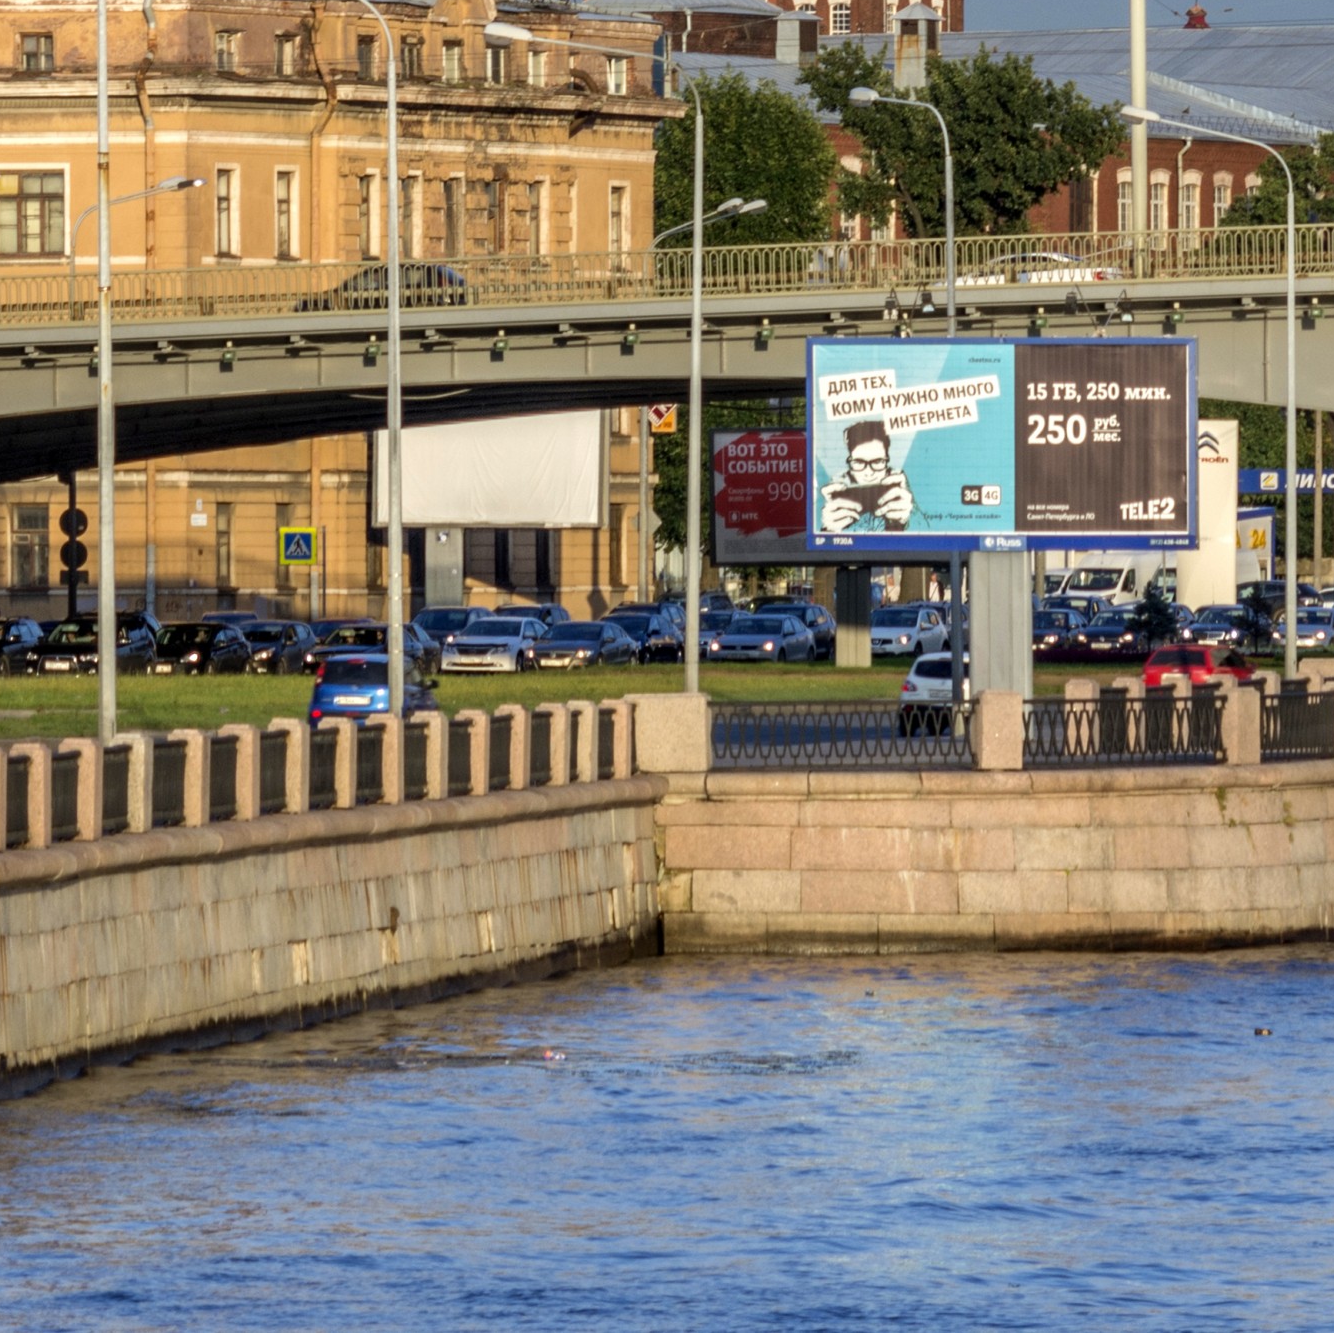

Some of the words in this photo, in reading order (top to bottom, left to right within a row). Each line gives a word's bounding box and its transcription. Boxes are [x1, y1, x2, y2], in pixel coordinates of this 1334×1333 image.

[828, 378, 857, 396] ДЛЯ
[861, 375, 893, 390] ТЕХ,
[1027, 383, 1047, 400] 15
[1053, 383, 1081, 403] ГБ,
[1086, 382, 1120, 400] 250
[1124, 387, 1171, 400] мин.
[832, 398, 876, 416] КОМУ
[881, 389, 939, 410] НУЖНО
[943, 381, 994, 400] МНОГО
[889, 405, 972, 430] ИНТЕРНЕТА
[1027, 413, 1087, 445] 250
[1094, 415, 1120, 430] руб.
[1093, 432, 1121, 442] мес.
[728, 443, 756, 457] ВОТ
[760, 443, 788, 457] ЭТО
[728, 459, 803, 474] СОБЫТИЕ!
[768, 481, 804, 501] 990
[964, 489, 979, 501] 3G
[985, 490, 998, 500] 4G
[1120, 497, 1175, 520] TELE2
[996, 537, 1022, 547] Russ
